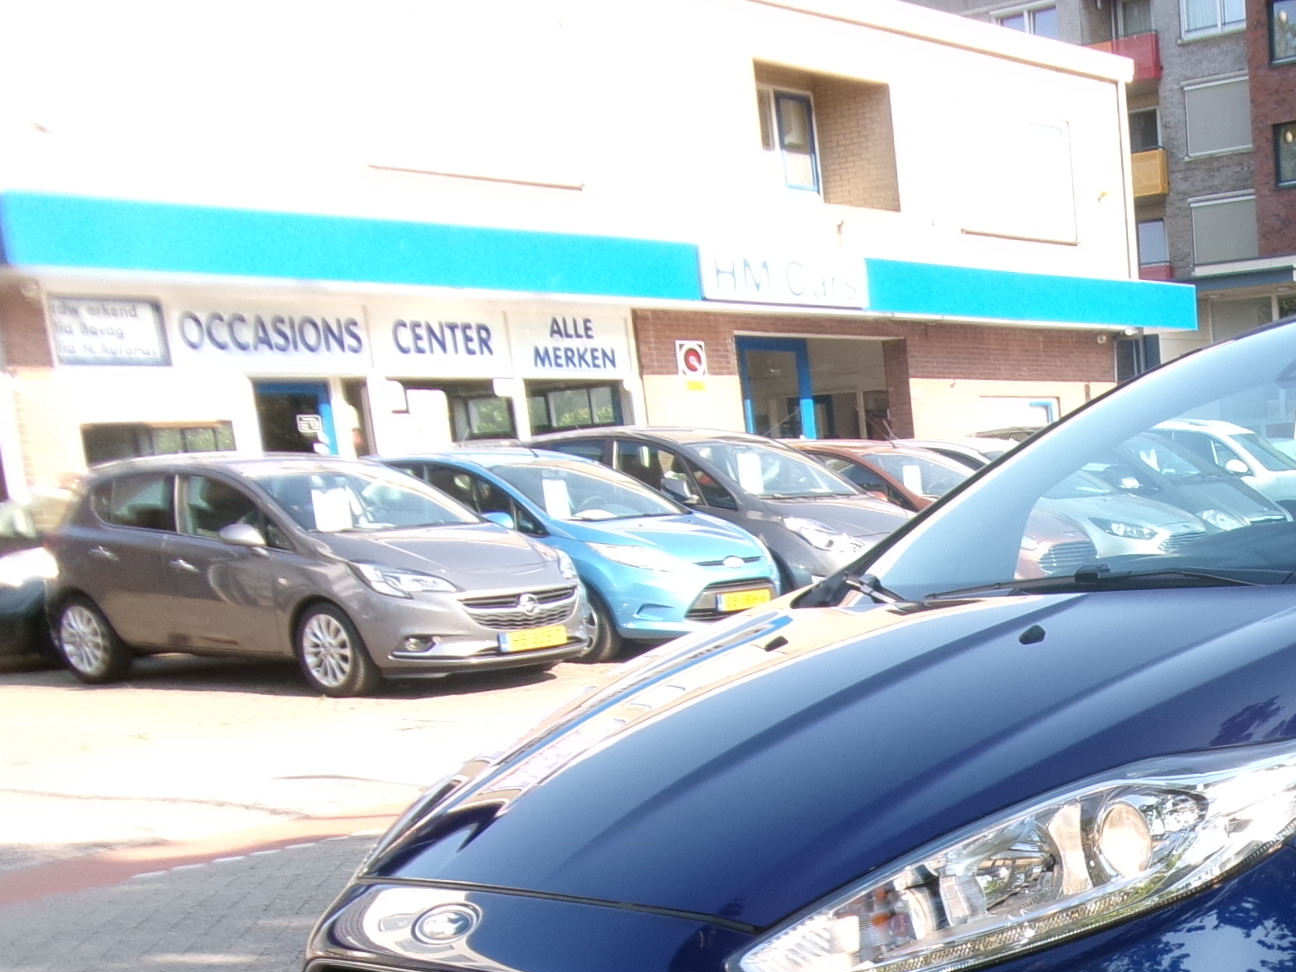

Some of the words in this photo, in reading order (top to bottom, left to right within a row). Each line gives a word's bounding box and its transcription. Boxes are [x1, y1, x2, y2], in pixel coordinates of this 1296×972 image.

[714, 256, 771, 292] HM
[178, 310, 363, 354] OCCASIONS
[392, 318, 494, 356] CENTER
[549, 316, 595, 340] ALLE
[533, 345, 618, 370] MERKEN
